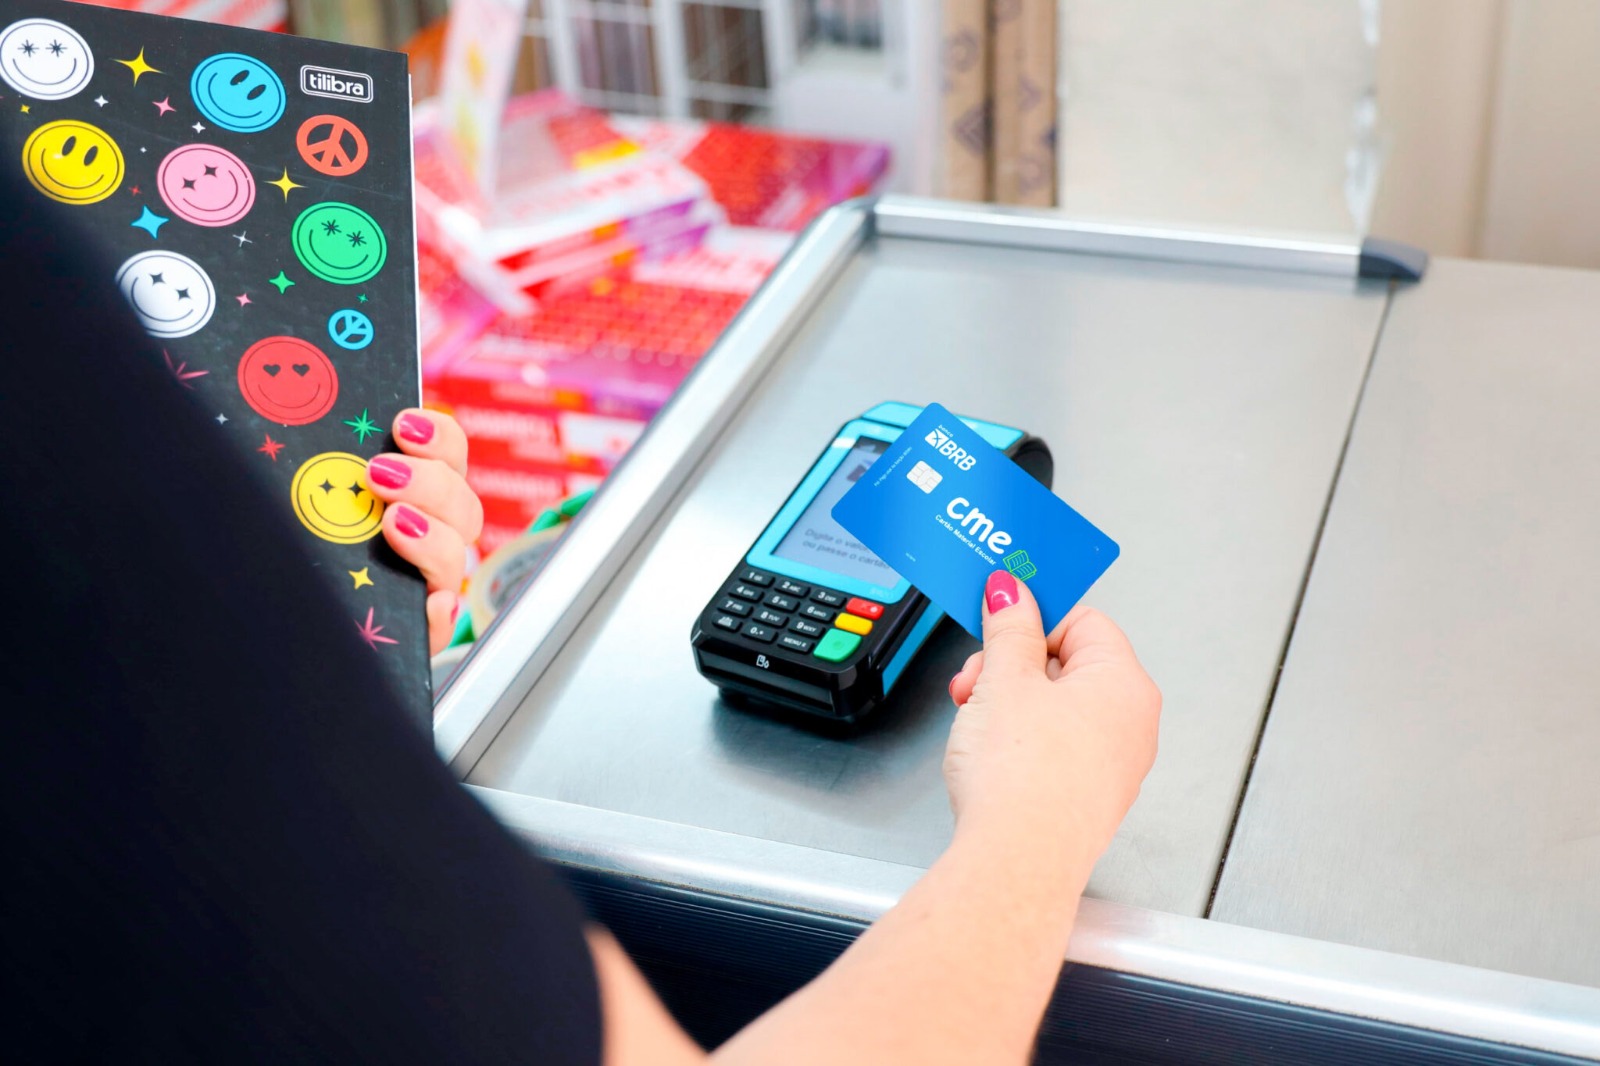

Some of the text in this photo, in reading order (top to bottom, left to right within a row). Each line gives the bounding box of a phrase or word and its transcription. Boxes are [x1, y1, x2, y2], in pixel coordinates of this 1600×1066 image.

[309, 73, 364, 96] tilibra
[938, 424, 954, 438] banco
[939, 440, 977, 471] BRB
[946, 497, 1012, 554] cme
[805, 528, 834, 542] Digite
[935, 514, 997, 566] Cartão Material Escolar
[816, 543, 848, 557] passe
[784, 637, 801, 646] MENU
